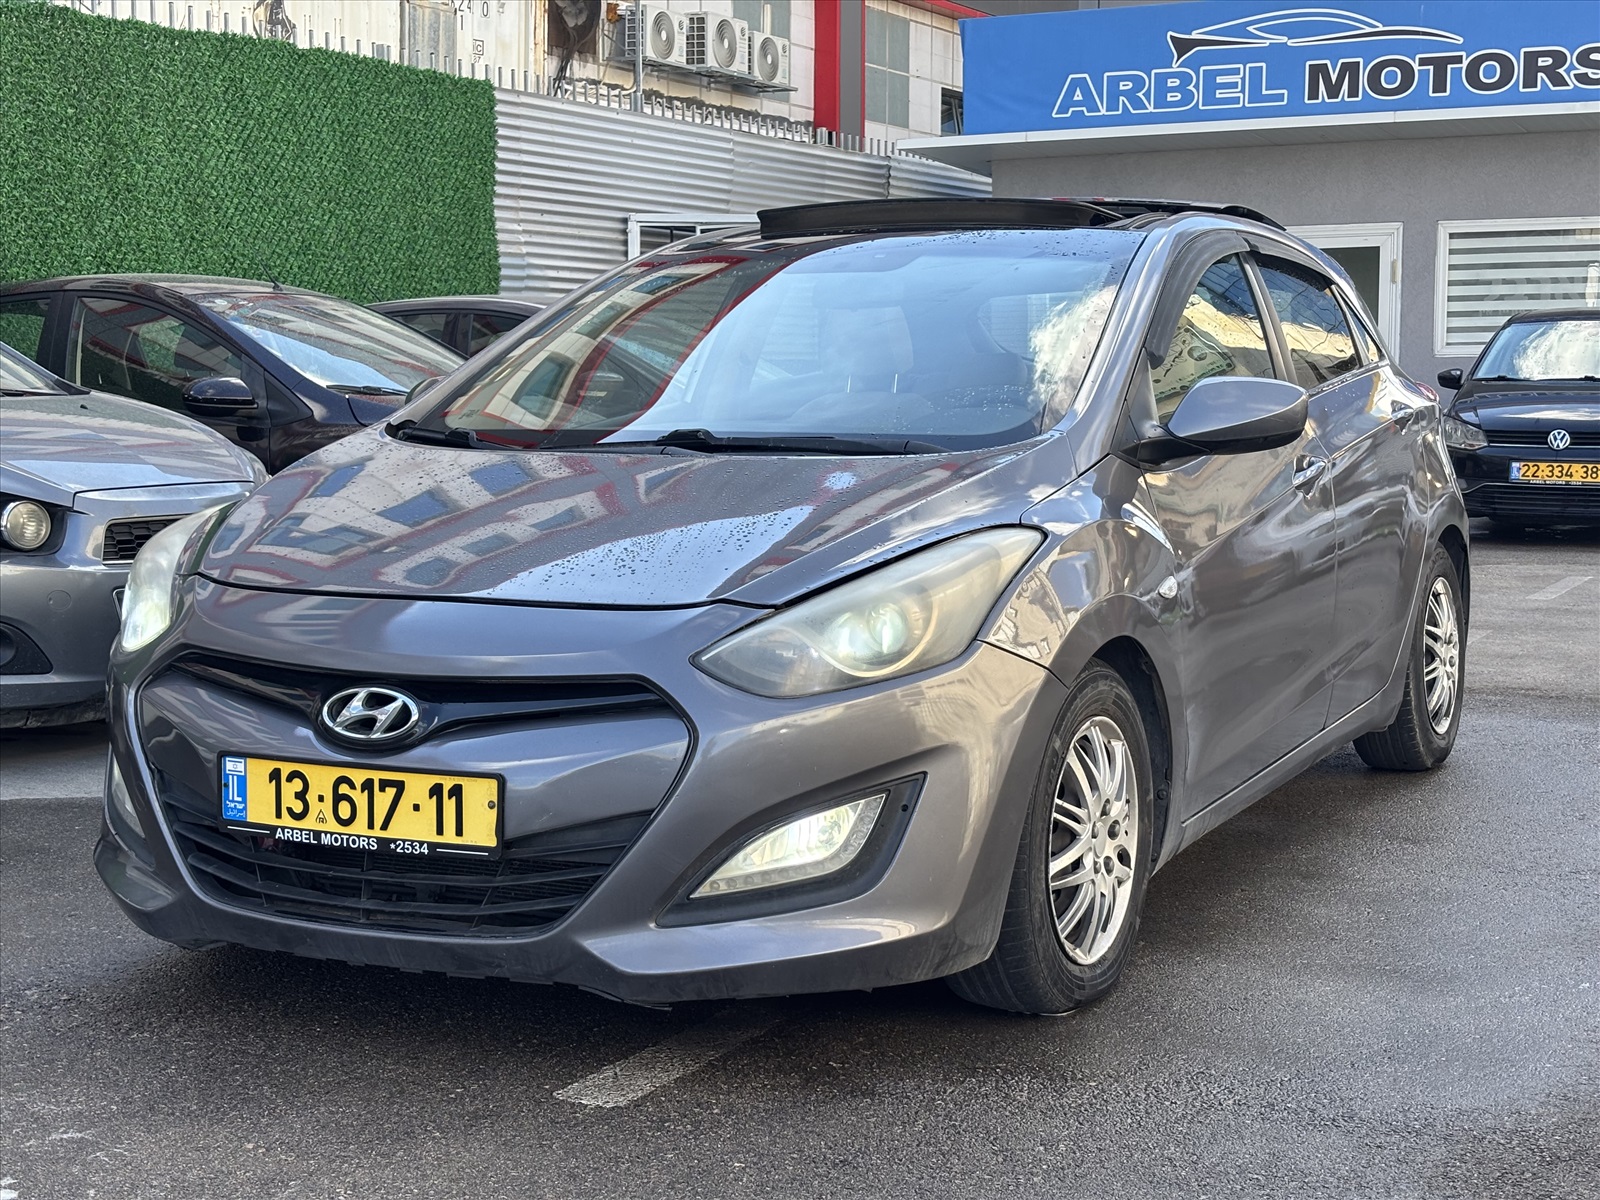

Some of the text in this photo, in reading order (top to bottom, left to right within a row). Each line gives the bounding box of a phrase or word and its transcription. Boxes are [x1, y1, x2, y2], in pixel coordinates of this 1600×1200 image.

[1052, 42, 1600, 118] ARBEL MOTORS
[228, 774, 242, 801] IL
[275, 827, 317, 845] ARBEL
[321, 832, 378, 851] MOTORS
